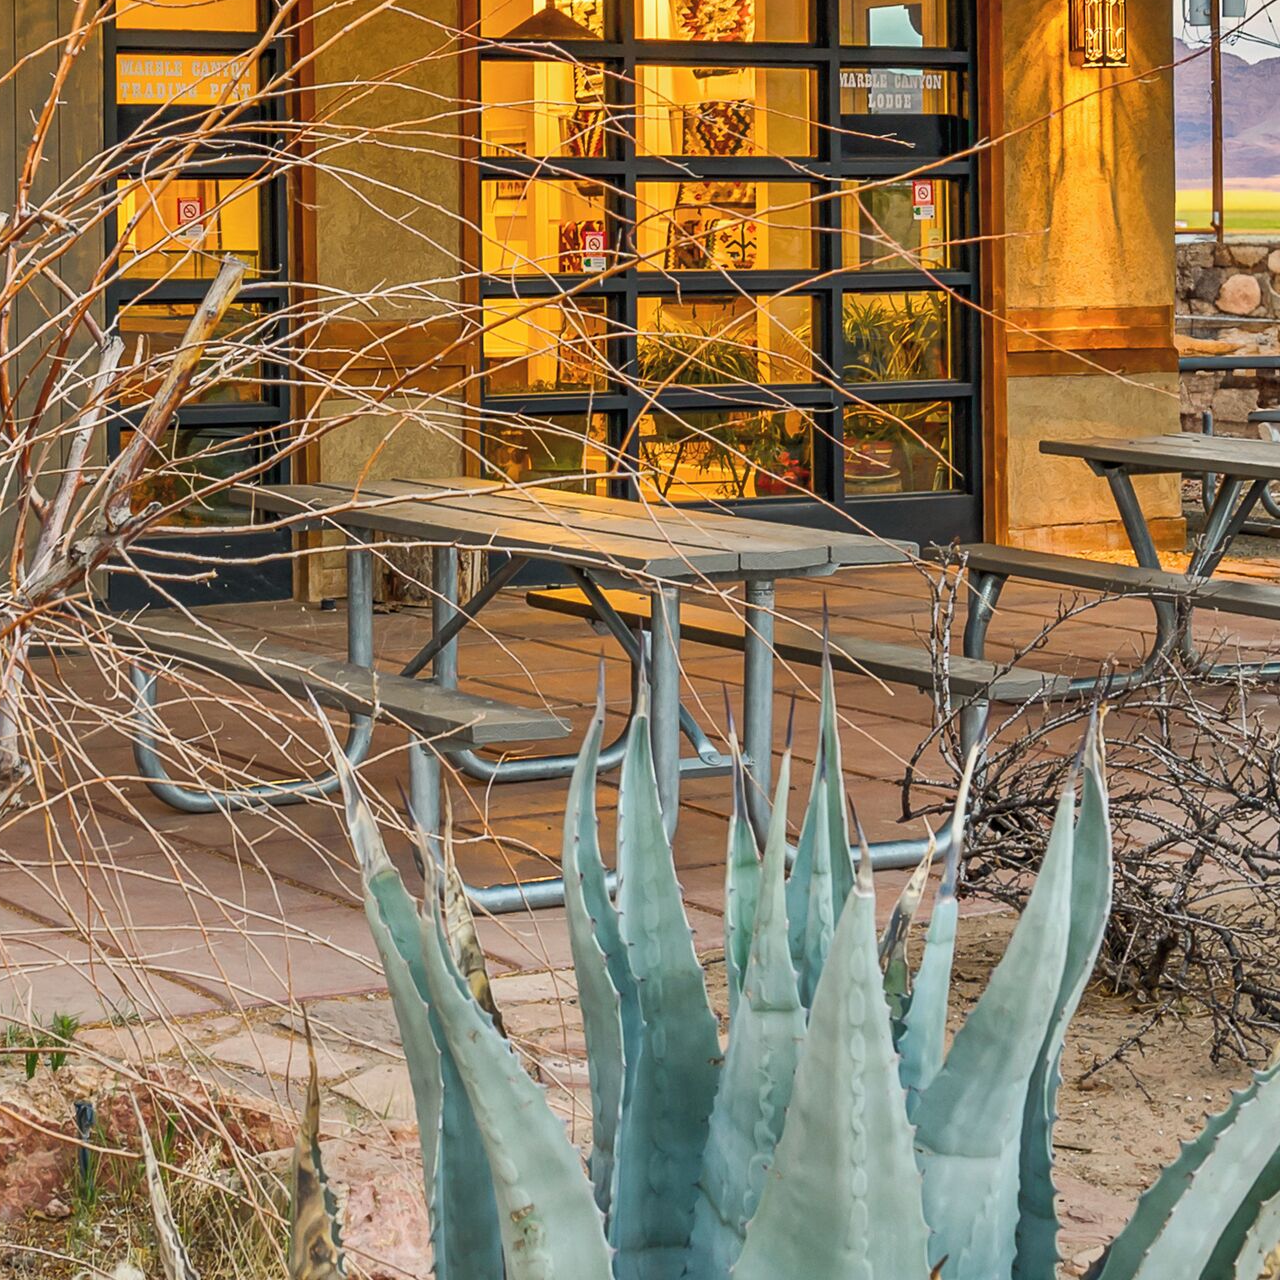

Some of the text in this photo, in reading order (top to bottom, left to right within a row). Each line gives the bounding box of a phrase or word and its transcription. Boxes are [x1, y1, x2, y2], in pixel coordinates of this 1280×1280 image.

[120, 60, 183, 77] MARBLE
[840, 72, 943, 90] MARBLE CANYON
[867, 93, 912, 109] LODGE
